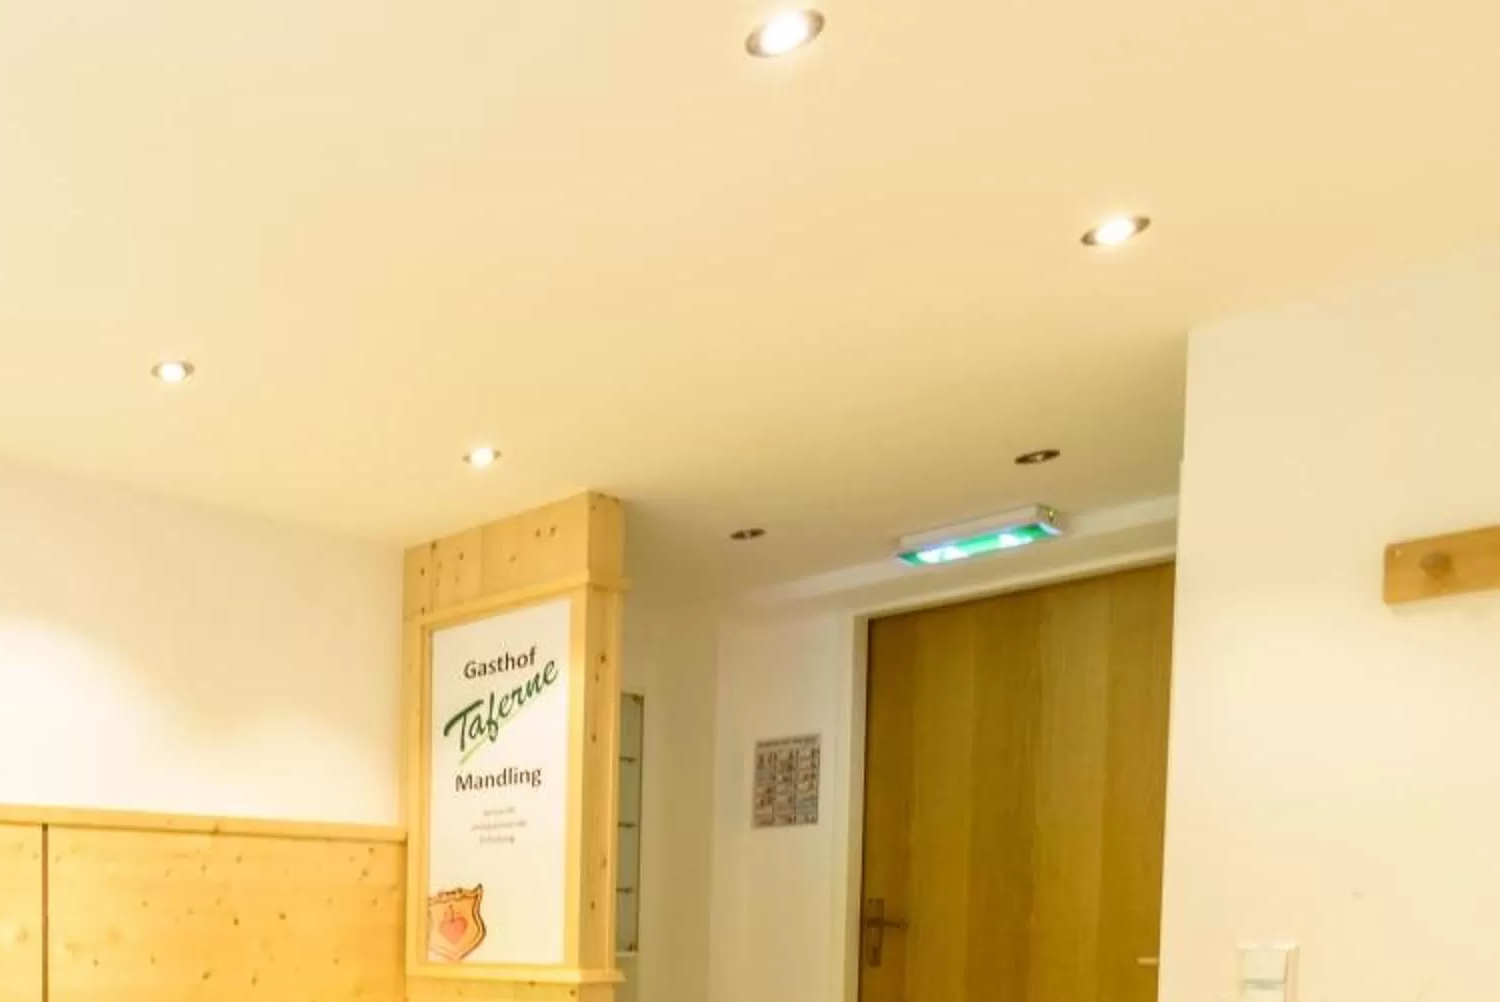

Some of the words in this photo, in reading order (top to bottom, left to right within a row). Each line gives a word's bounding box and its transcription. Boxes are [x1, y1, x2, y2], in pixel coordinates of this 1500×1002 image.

[463, 645, 537, 679] Gasthof
[443, 658, 559, 752] Taferne
[455, 767, 542, 792] Mandling
